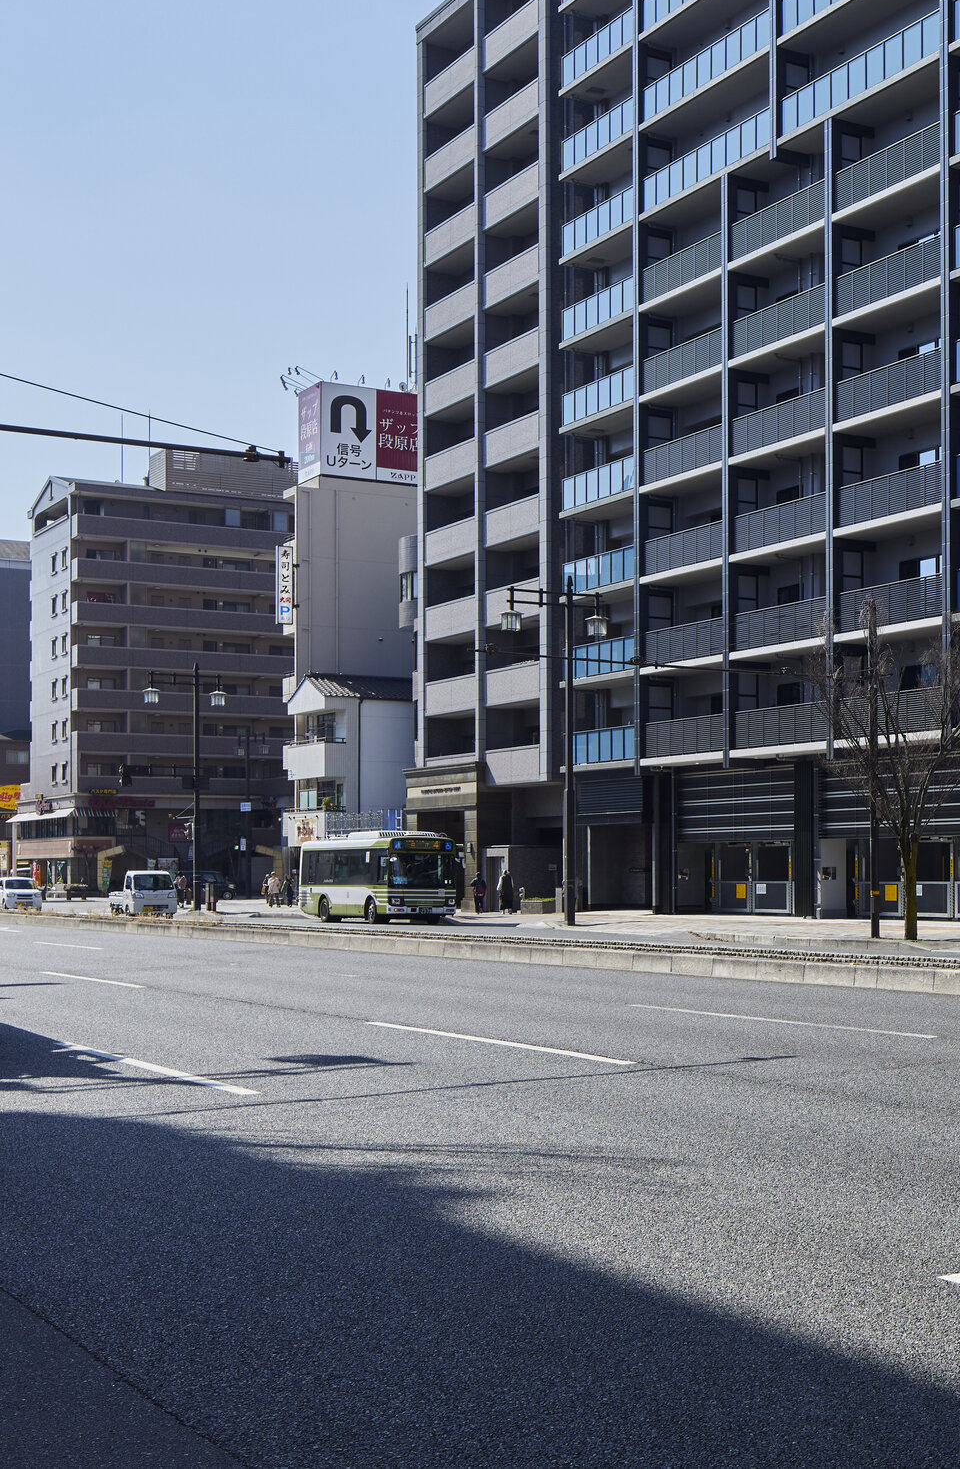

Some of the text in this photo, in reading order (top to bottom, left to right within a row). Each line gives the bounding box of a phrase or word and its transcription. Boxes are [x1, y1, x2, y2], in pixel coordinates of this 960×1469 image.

[336, 442, 362, 458] 信号
[326, 454, 372, 470] Uターン
[390, 471, 416, 482] ZAPP
[280, 549, 291, 594] 寿司とみ
[280, 605, 290, 616] P
